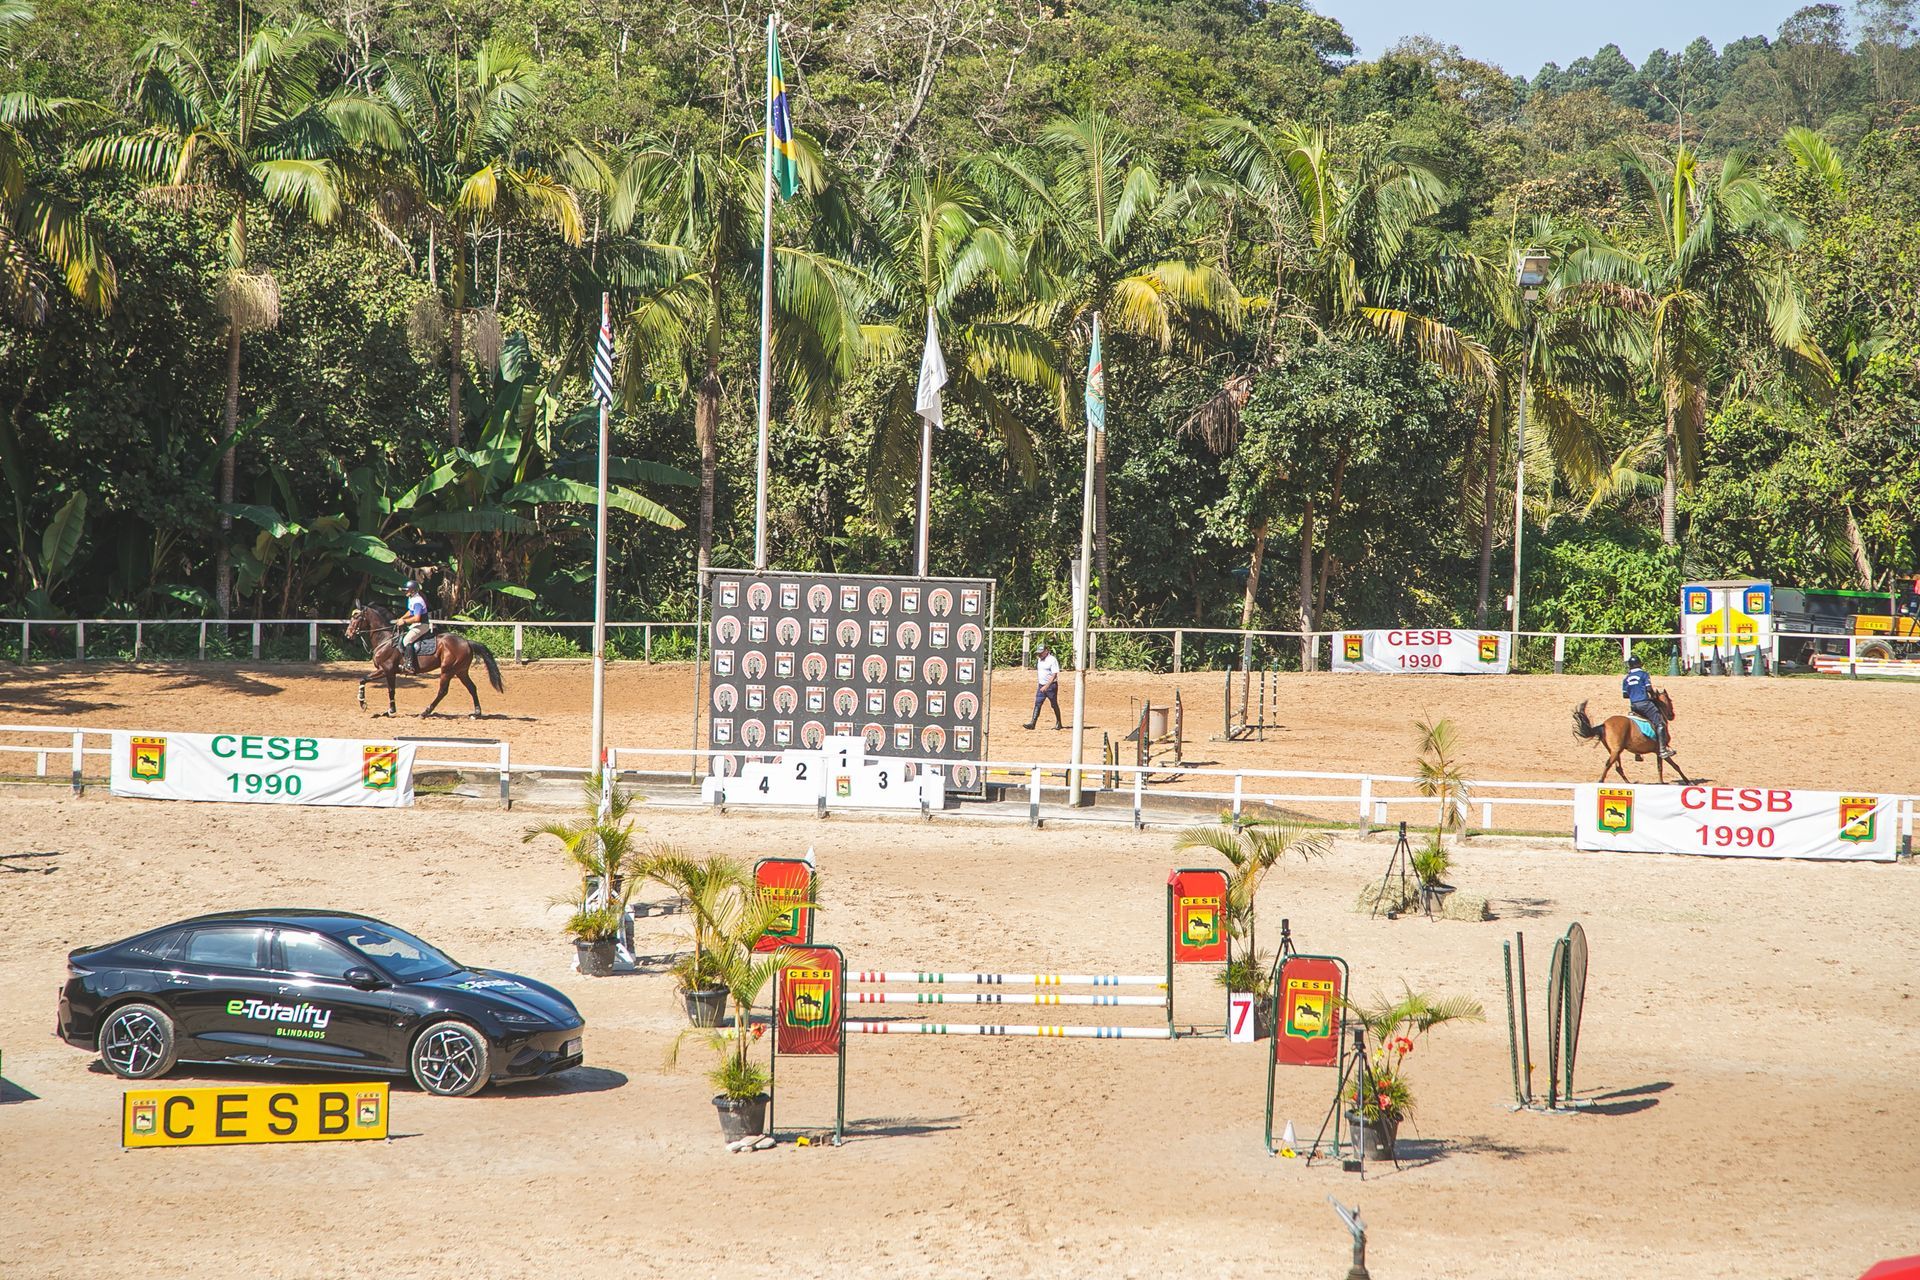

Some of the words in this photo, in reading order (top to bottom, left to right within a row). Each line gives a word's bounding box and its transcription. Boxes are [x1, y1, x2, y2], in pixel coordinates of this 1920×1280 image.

[1387, 630, 1453, 646] CESB
[1398, 654, 1443, 668] 1990
[211, 735, 319, 761] CESB
[796, 762, 807, 780] 2
[878, 771, 888, 789] 3
[227, 773, 302, 796] 1990
[759, 776, 769, 793] 4
[1680, 786, 1793, 813] CESB
[1696, 825, 1775, 848] 1990
[790, 970, 831, 978] CESB
[1290, 980, 1331, 990] CESB
[226, 999, 331, 1029] e-Totality
[1232, 1000, 1251, 1035] 7
[276, 1027, 326, 1040] BLINDADOS
